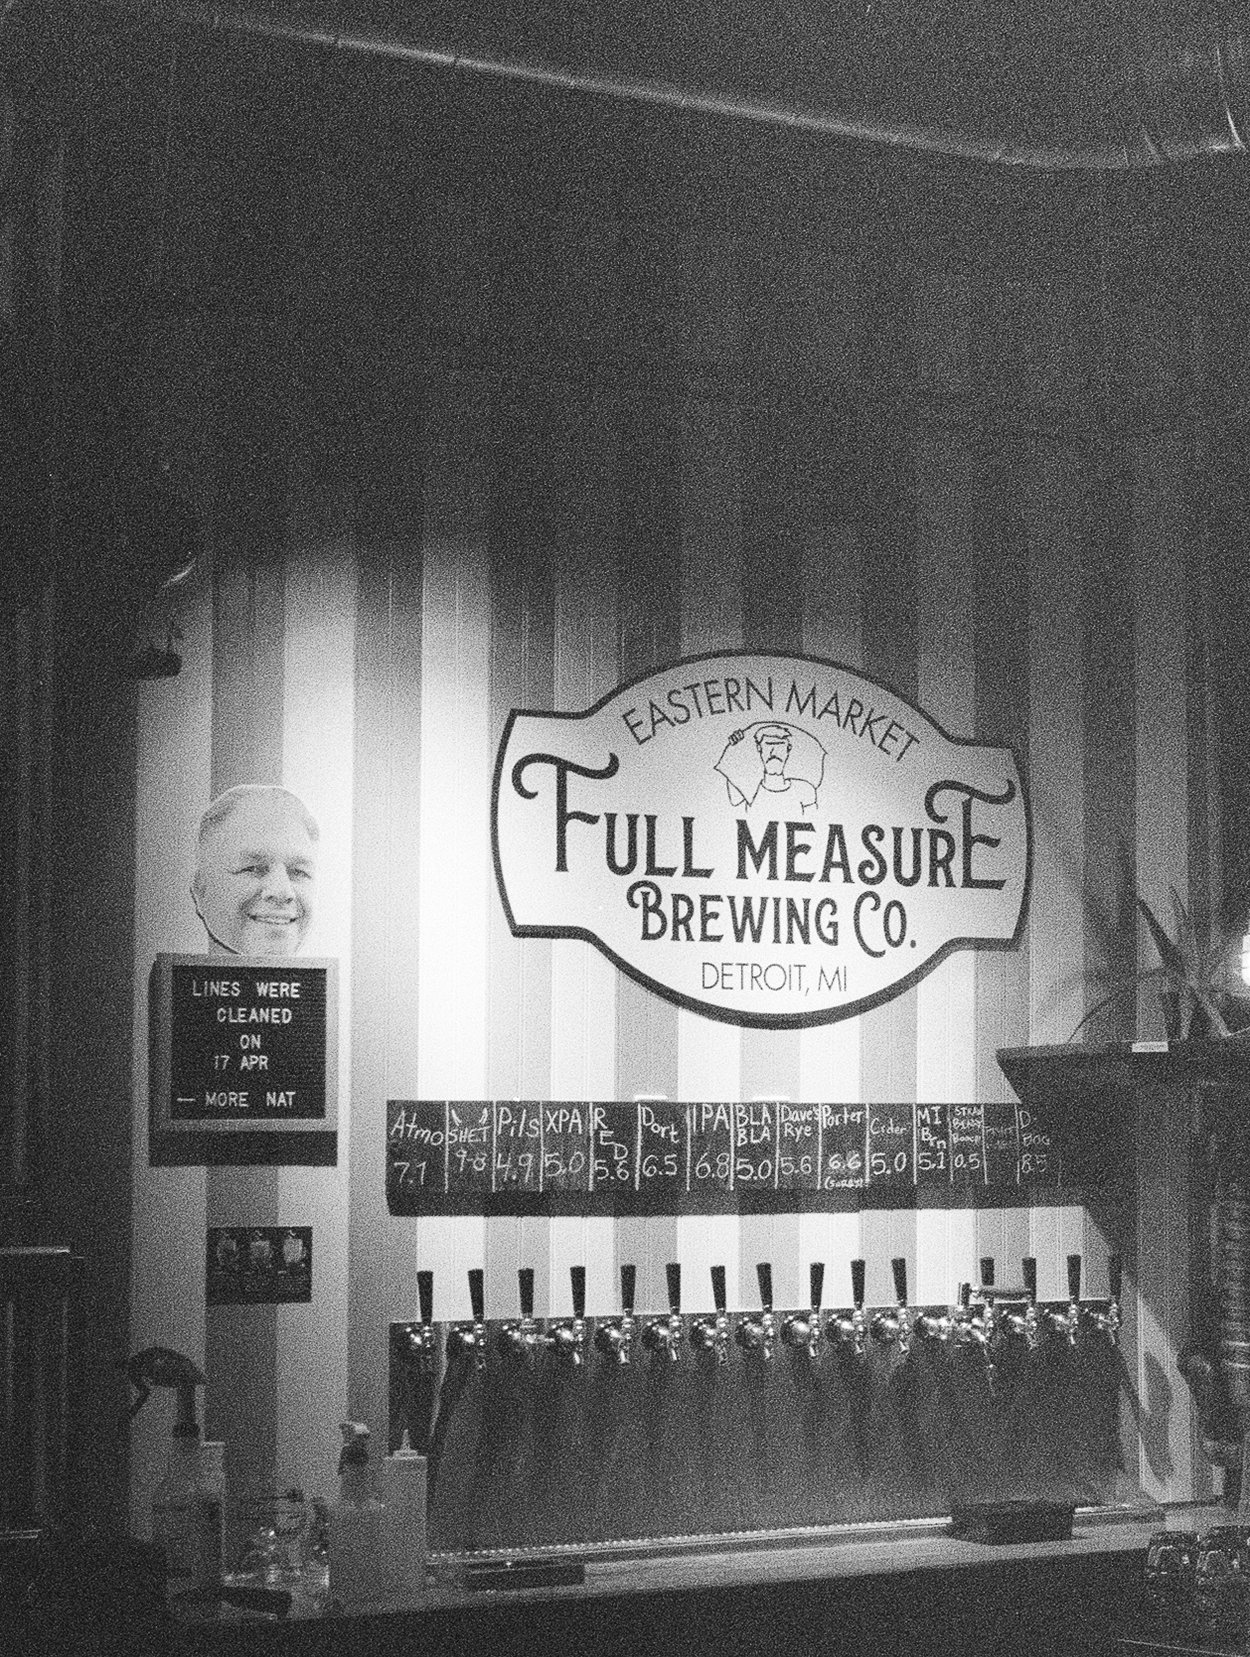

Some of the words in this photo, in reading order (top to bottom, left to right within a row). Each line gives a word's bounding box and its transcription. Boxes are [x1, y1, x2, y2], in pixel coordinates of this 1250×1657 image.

[622, 676, 776, 745] EASTERN
[784, 678, 921, 763] MARKET
[511, 753, 716, 879] FULL
[735, 778, 1017, 891] MEASURE
[626, 880, 840, 946] BREWING
[852, 890, 918, 958] CO.
[192, 981, 241, 997] LINES
[255, 982, 301, 998] WERE
[700, 961, 811, 998] DETROIT,
[818, 966, 849, 993] MI
[216, 1008, 293, 1024] CLEANED
[240, 1034, 261, 1049] ON
[213, 1055, 231, 1070] 17
[239, 1055, 269, 1071] APR
[205, 1091, 250, 1108] MORE
[266, 1091, 296, 1107] NAT
[498, 1106, 541, 1138] Pils
[545, 1108, 583, 1134] XPA
[641, 1106, 680, 1144] Dort
[693, 1103, 730, 1133] IPA
[735, 1104, 771, 1126] BLA
[822, 1104, 864, 1129] Porter
[871, 1117, 907, 1135] Cider
[917, 1106, 942, 1126] MI
[390, 1109, 445, 1146] Atmo
[737, 1126, 771, 1147] BLA
[784, 1122, 812, 1142] Rye
[496, 1152, 535, 1183] 4.9
[594, 1159, 630, 1181] 5.6
[642, 1153, 678, 1177] 6.5
[696, 1152, 730, 1179] 6.8
[736, 1158, 772, 1180] 5.0
[781, 1155, 812, 1175] 5.6
[829, 1153, 861, 1170] 6.6
[871, 1152, 907, 1175] 5.0
[918, 1151, 946, 1170] 5.1
[954, 1152, 981, 1170] 0.5
[394, 1161, 427, 1186] 7.1
